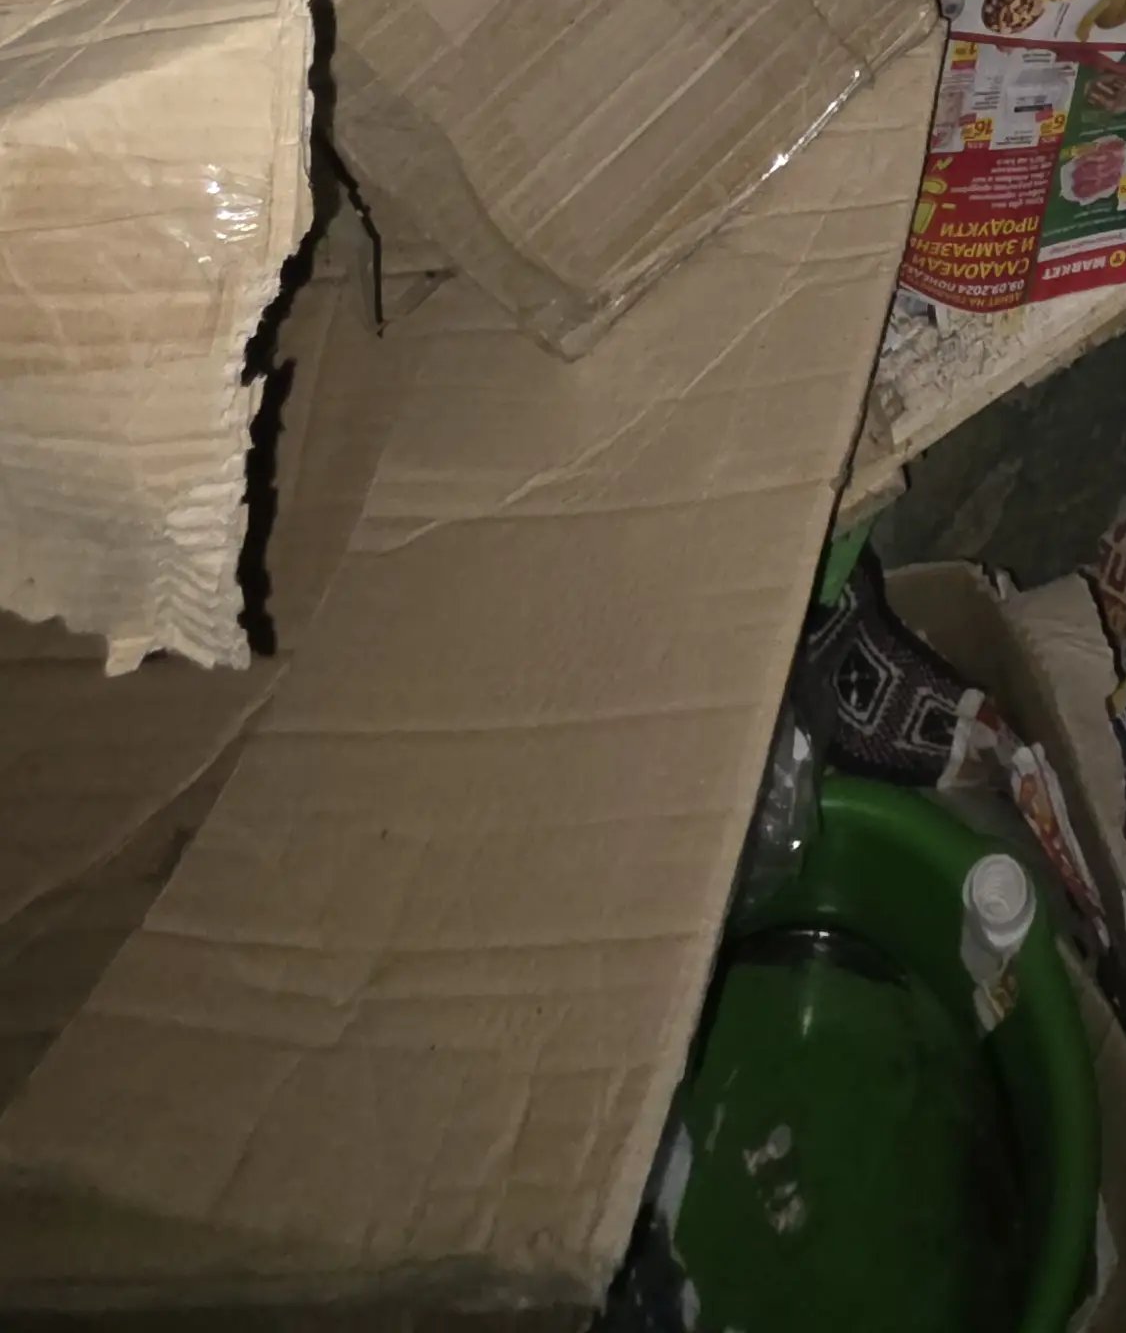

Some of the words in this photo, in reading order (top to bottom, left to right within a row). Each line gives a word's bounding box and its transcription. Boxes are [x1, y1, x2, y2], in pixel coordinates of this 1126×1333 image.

[940, 215, 1039, 238] ПРОДУКТИ
[1021, 236, 1035, 252] И
[911, 254, 1030, 279] СЛАДОЛЕДИ
[1042, 256, 1106, 280] MARKET
